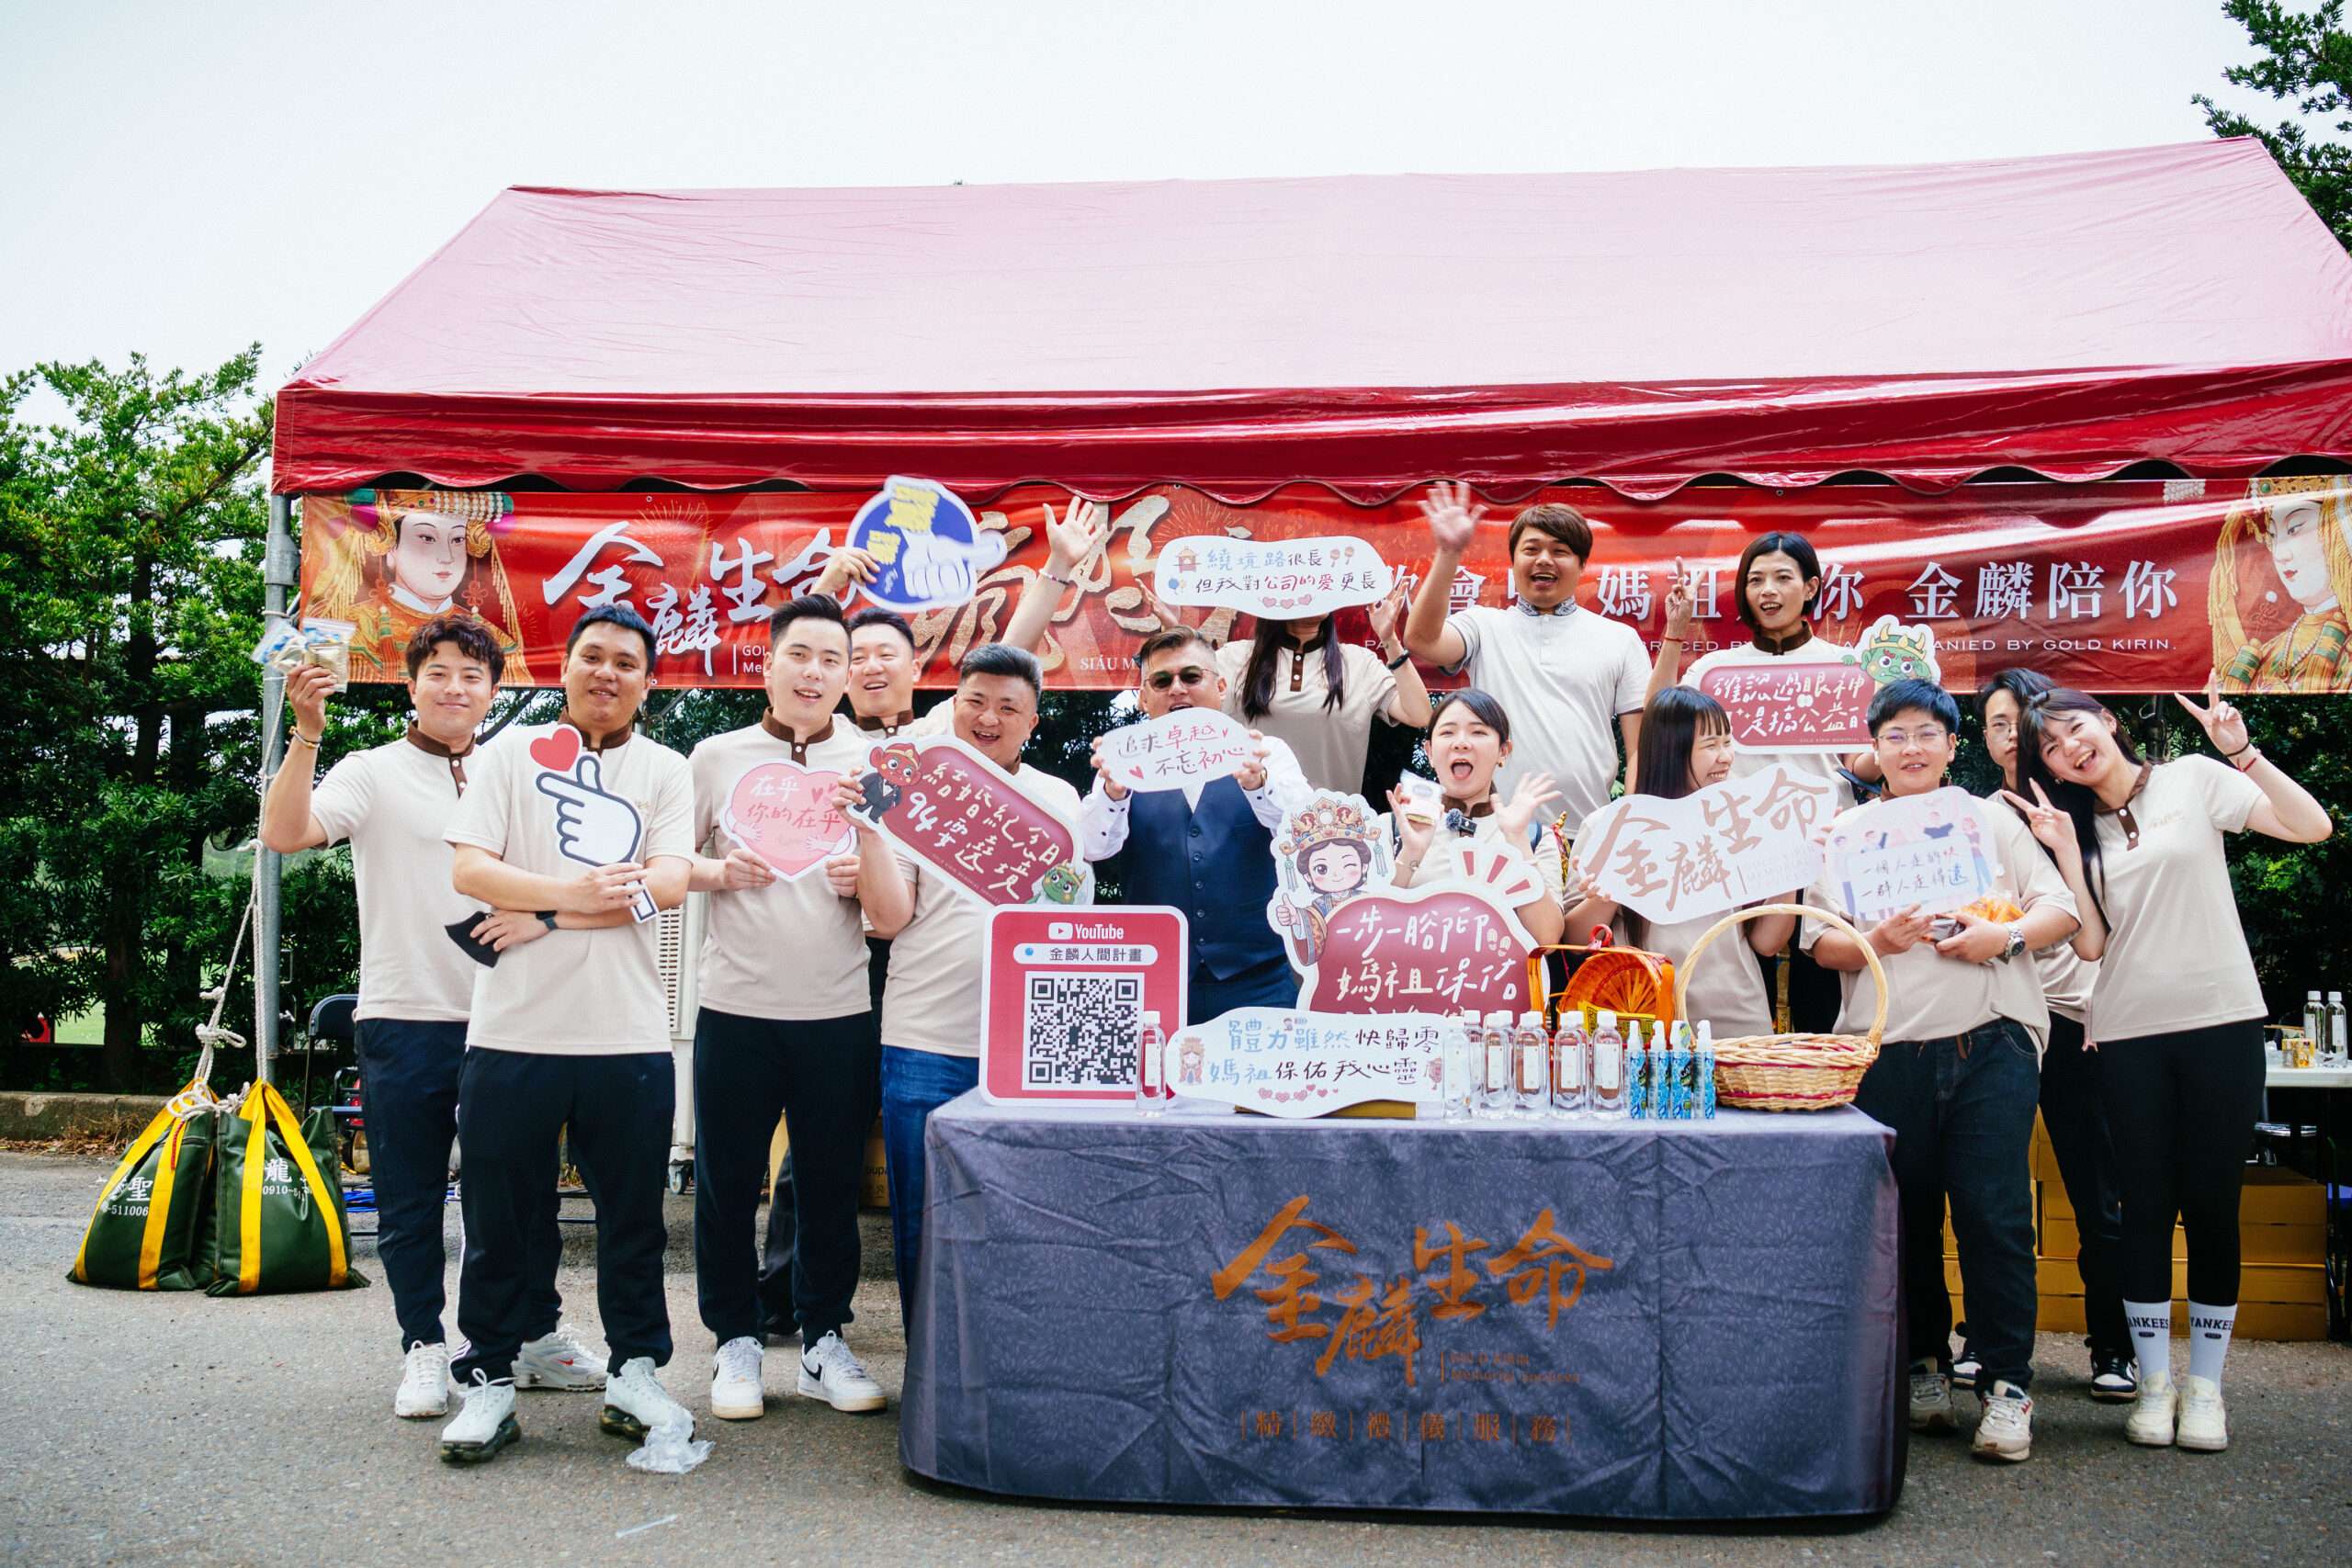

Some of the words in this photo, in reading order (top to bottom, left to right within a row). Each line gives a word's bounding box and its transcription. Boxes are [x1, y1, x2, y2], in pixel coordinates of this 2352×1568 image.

[1196, 570, 1376, 592] 但我對公司的愛更長
[1905, 560, 2177, 620] 金麟陪你
[2007, 639, 2034, 651] BY
[2042, 639, 2101, 651] GOLD
[2112, 639, 2177, 650] KIRIN.
[1116, 723, 1219, 758] 追求卓越
[1155, 748, 1245, 776] 不忘初心
[750, 774, 801, 802] 在乎
[747, 802, 842, 834] 你的在乎
[922, 762, 1059, 865] 結婚紀念日
[1583, 768, 1829, 911] 金麟生命
[1075, 923, 1125, 940] YouTube
[1336, 905, 1489, 958] 一步一腳印
[1048, 947, 1142, 963] 金麟人間計畫
[1337, 957, 1517, 1004] 媽祖保佑
[1228, 1019, 1440, 1054] 體力雖然快歸零
[1209, 1057, 1418, 1086] 媽祖保佑我心靈
[1211, 1194, 1614, 1389] 金麟生命
[2127, 1315, 2169, 1329] ANKEES
